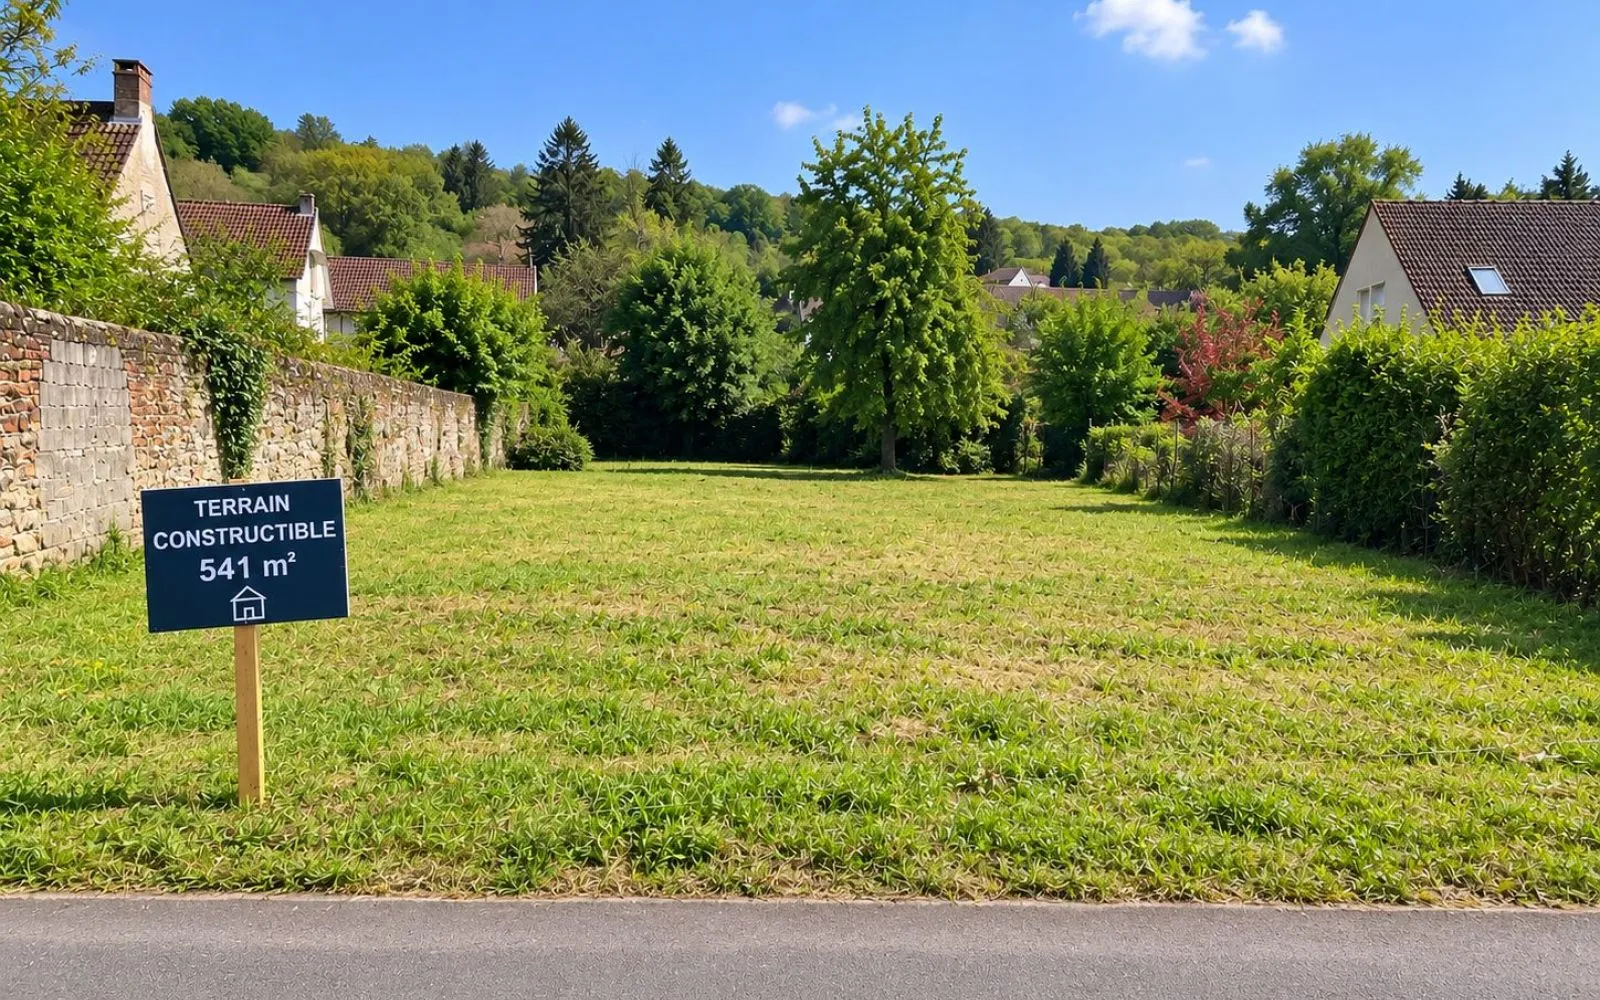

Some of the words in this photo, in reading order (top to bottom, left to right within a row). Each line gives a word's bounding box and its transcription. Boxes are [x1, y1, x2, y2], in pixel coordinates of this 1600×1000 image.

[194, 494, 290, 517] TERRAIN
[153, 520, 337, 550] CONSTRUCTIBLE
[199, 556, 250, 582] 541
[263, 551, 296, 577] m²
